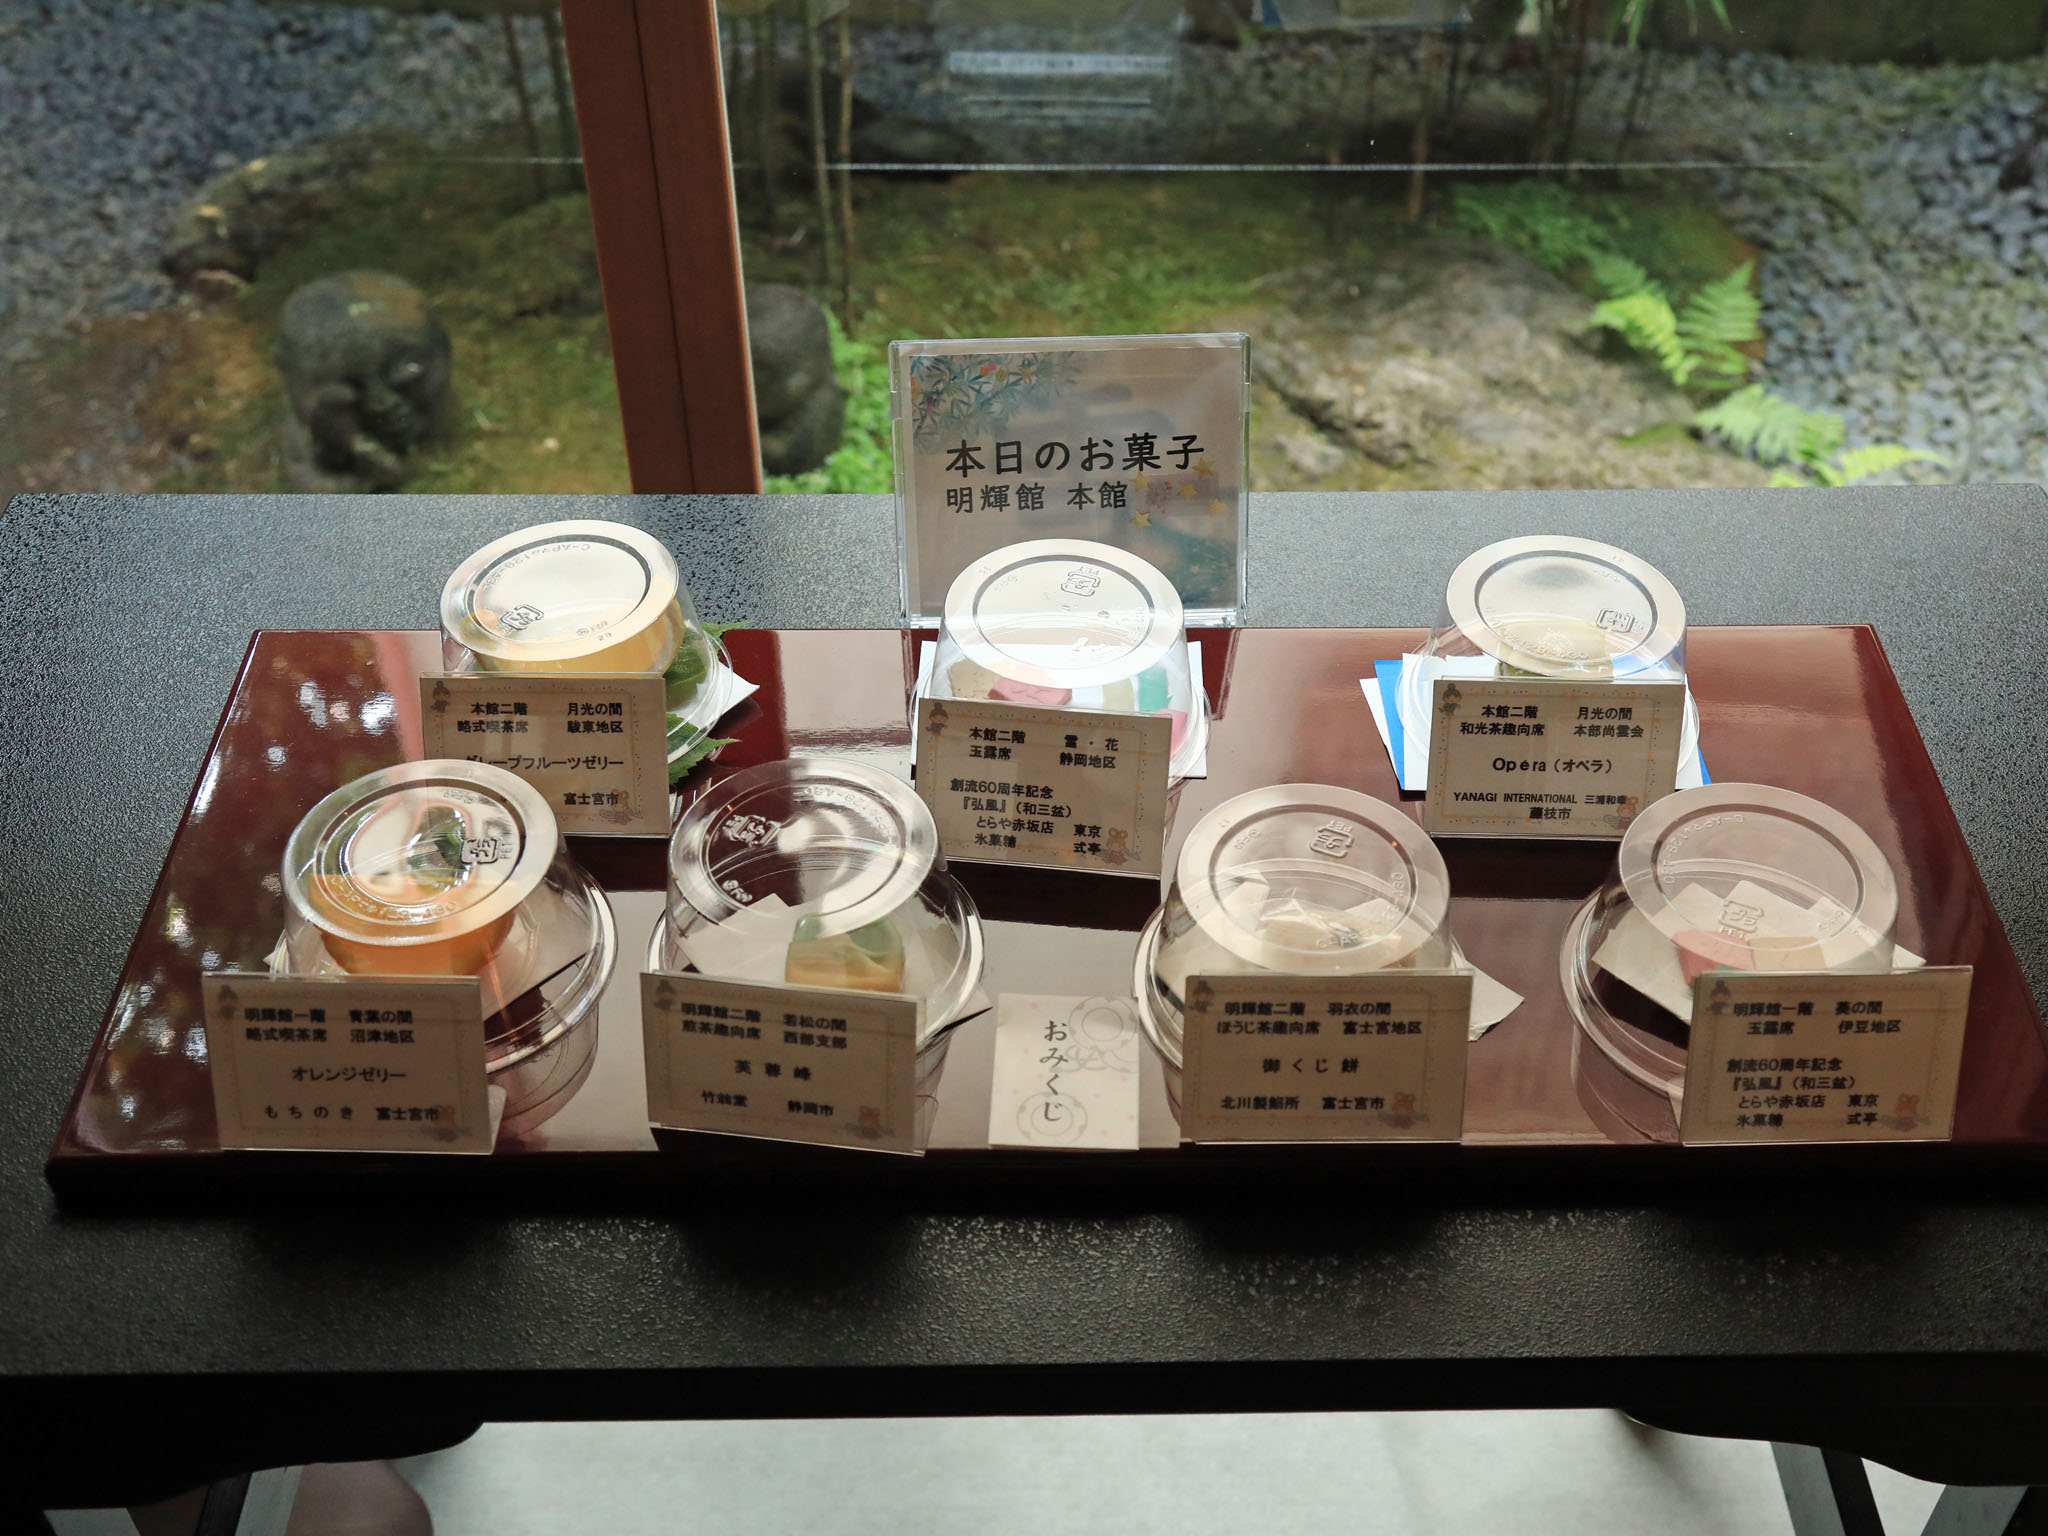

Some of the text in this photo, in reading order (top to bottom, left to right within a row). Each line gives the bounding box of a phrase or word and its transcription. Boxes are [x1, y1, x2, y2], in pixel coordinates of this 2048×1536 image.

[944, 432, 1205, 478] 本日のお菓子
[947, 481, 1128, 513] 明輝館 本館
[471, 702, 623, 716] 本館二階 月光の間
[1481, 706, 1633, 721] 本館二階 月光の間
[457, 720, 623, 734] 略式喫茶席 駿東地区
[1460, 723, 1545, 736] 和光茶趣向席
[969, 727, 1026, 744] 本館二階
[969, 745, 1116, 768] 玉露席 静岡地区
[950, 779, 1054, 799] 創流60周年記念
[564, 793, 619, 805] 富士宮市
[1454, 792, 1497, 802] YANAGI
[1503, 793, 1577, 804] INTERNATIONAL
[1529, 807, 1572, 820] 藤枝市
[976, 816, 1101, 838] とらや赤坂店 東京
[1073, 842, 1101, 855] 式亭
[1225, 1001, 1392, 1016] 明輝館二階 羽衣の間
[349, 1009, 414, 1024] 青葉の間
[1343, 1021, 1423, 1035] 富士宮地区
[1838, 1019, 1901, 1034] 伊豆地区
[351, 1029, 415, 1043] 沼津地区
[783, 1031, 847, 1049] 西部支部
[1040, 1020, 1068, 1122] おみくじ
[1726, 1058, 1844, 1073] 創流60周年記念
[292, 1067, 407, 1082] オレンジゼリー
[787, 1100, 834, 1117] 静岡市
[1322, 1096, 1385, 1110] 富士宮市
[1738, 1094, 1879, 1108] とらや赤坂店 東京
[265, 1105, 440, 1121] もちのき 富士宮市
